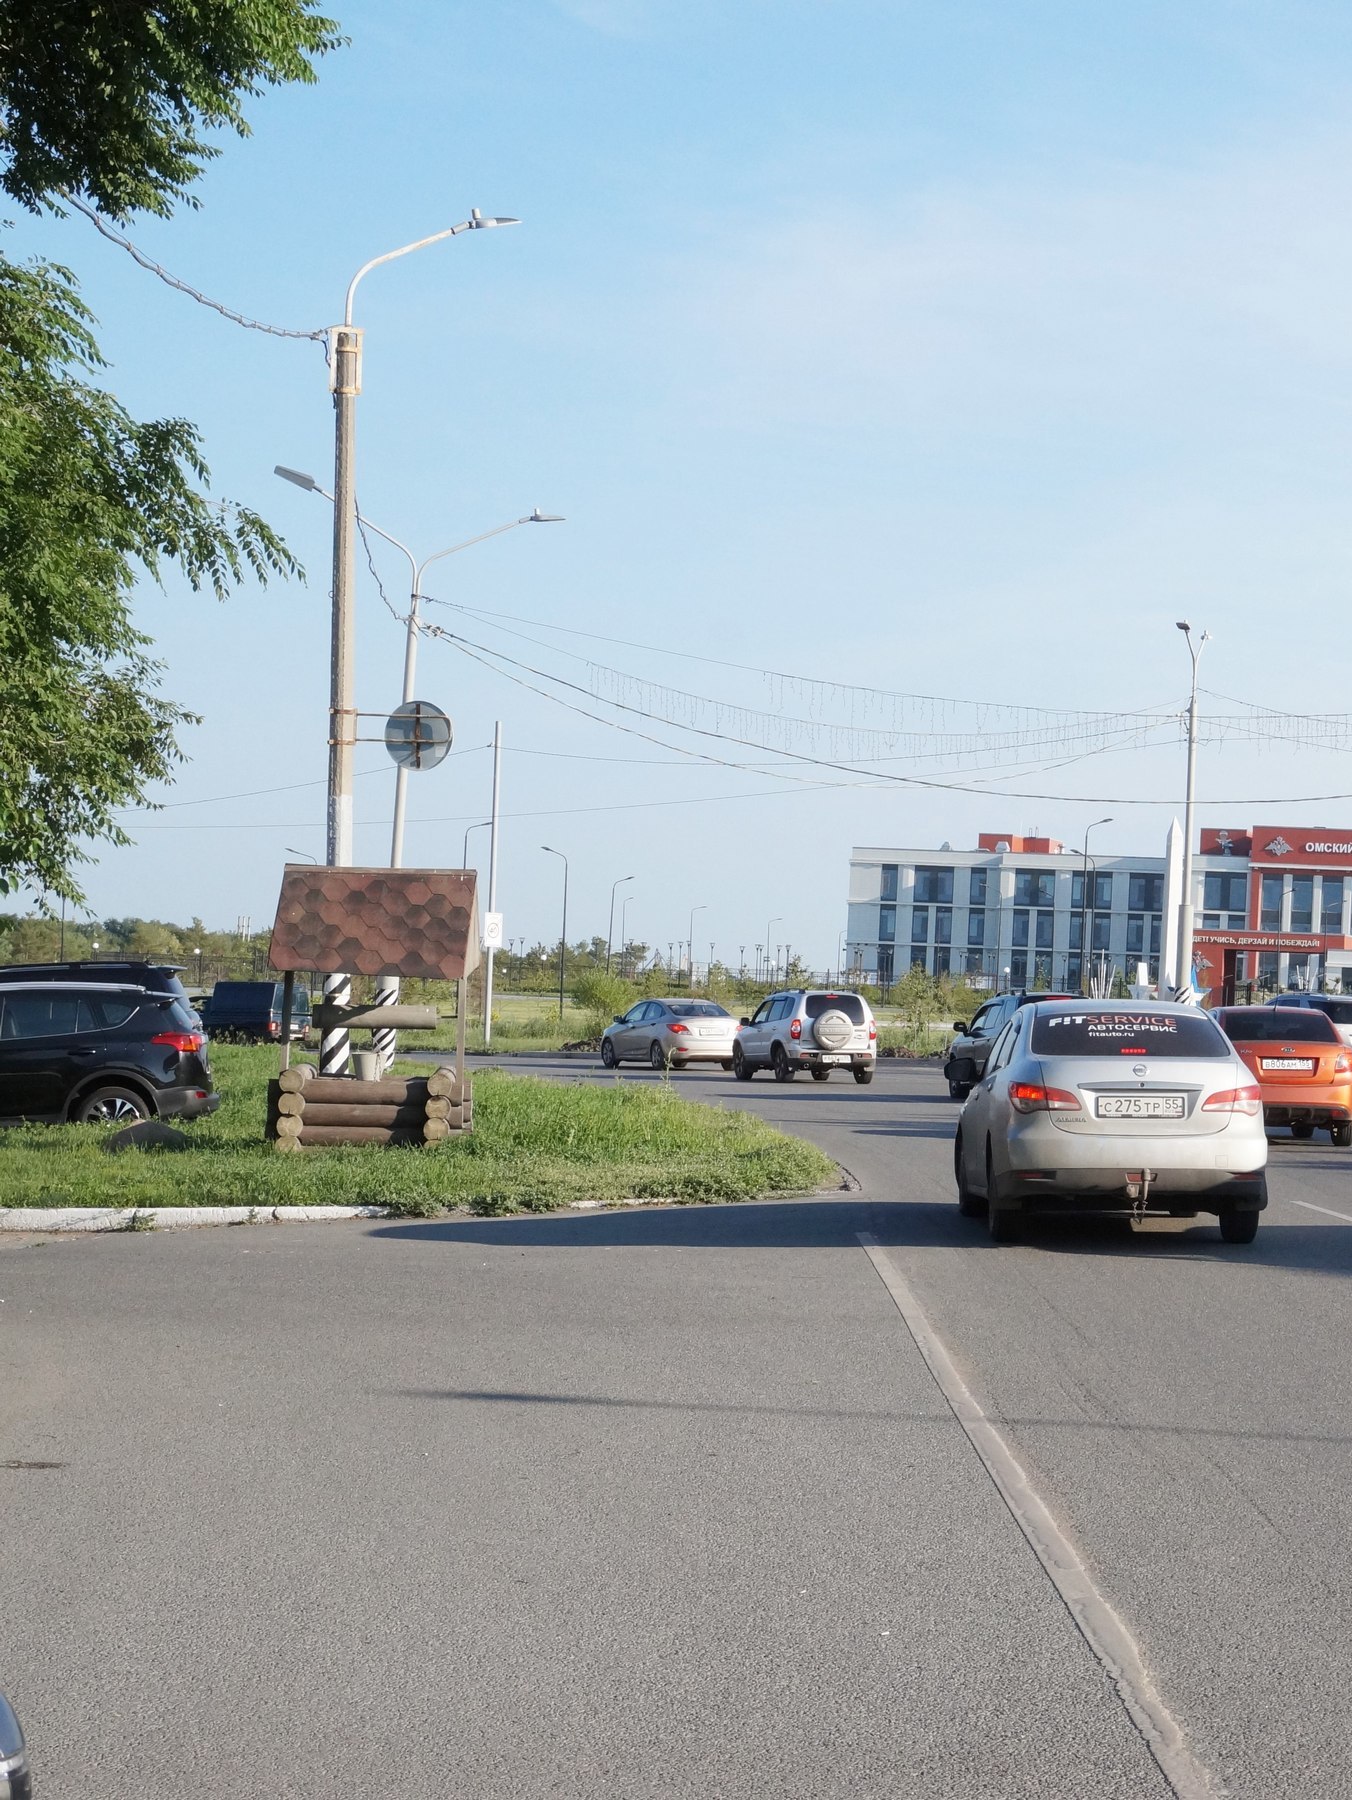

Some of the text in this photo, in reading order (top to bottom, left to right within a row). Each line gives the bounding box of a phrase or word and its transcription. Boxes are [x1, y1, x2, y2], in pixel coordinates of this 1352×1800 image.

[1192, 935, 1208, 943] ДЕТ!
[1210, 936, 1237, 944] УЧИСЬ,
[1238, 937, 1268, 945] ДЕРЗАЙ
[1276, 938, 1320, 947] ПОБЕЖДАЙ!
[1088, 1024, 1178, 1033] АВТОСЕРВИС
[1164, 1099, 1179, 1110] 55
